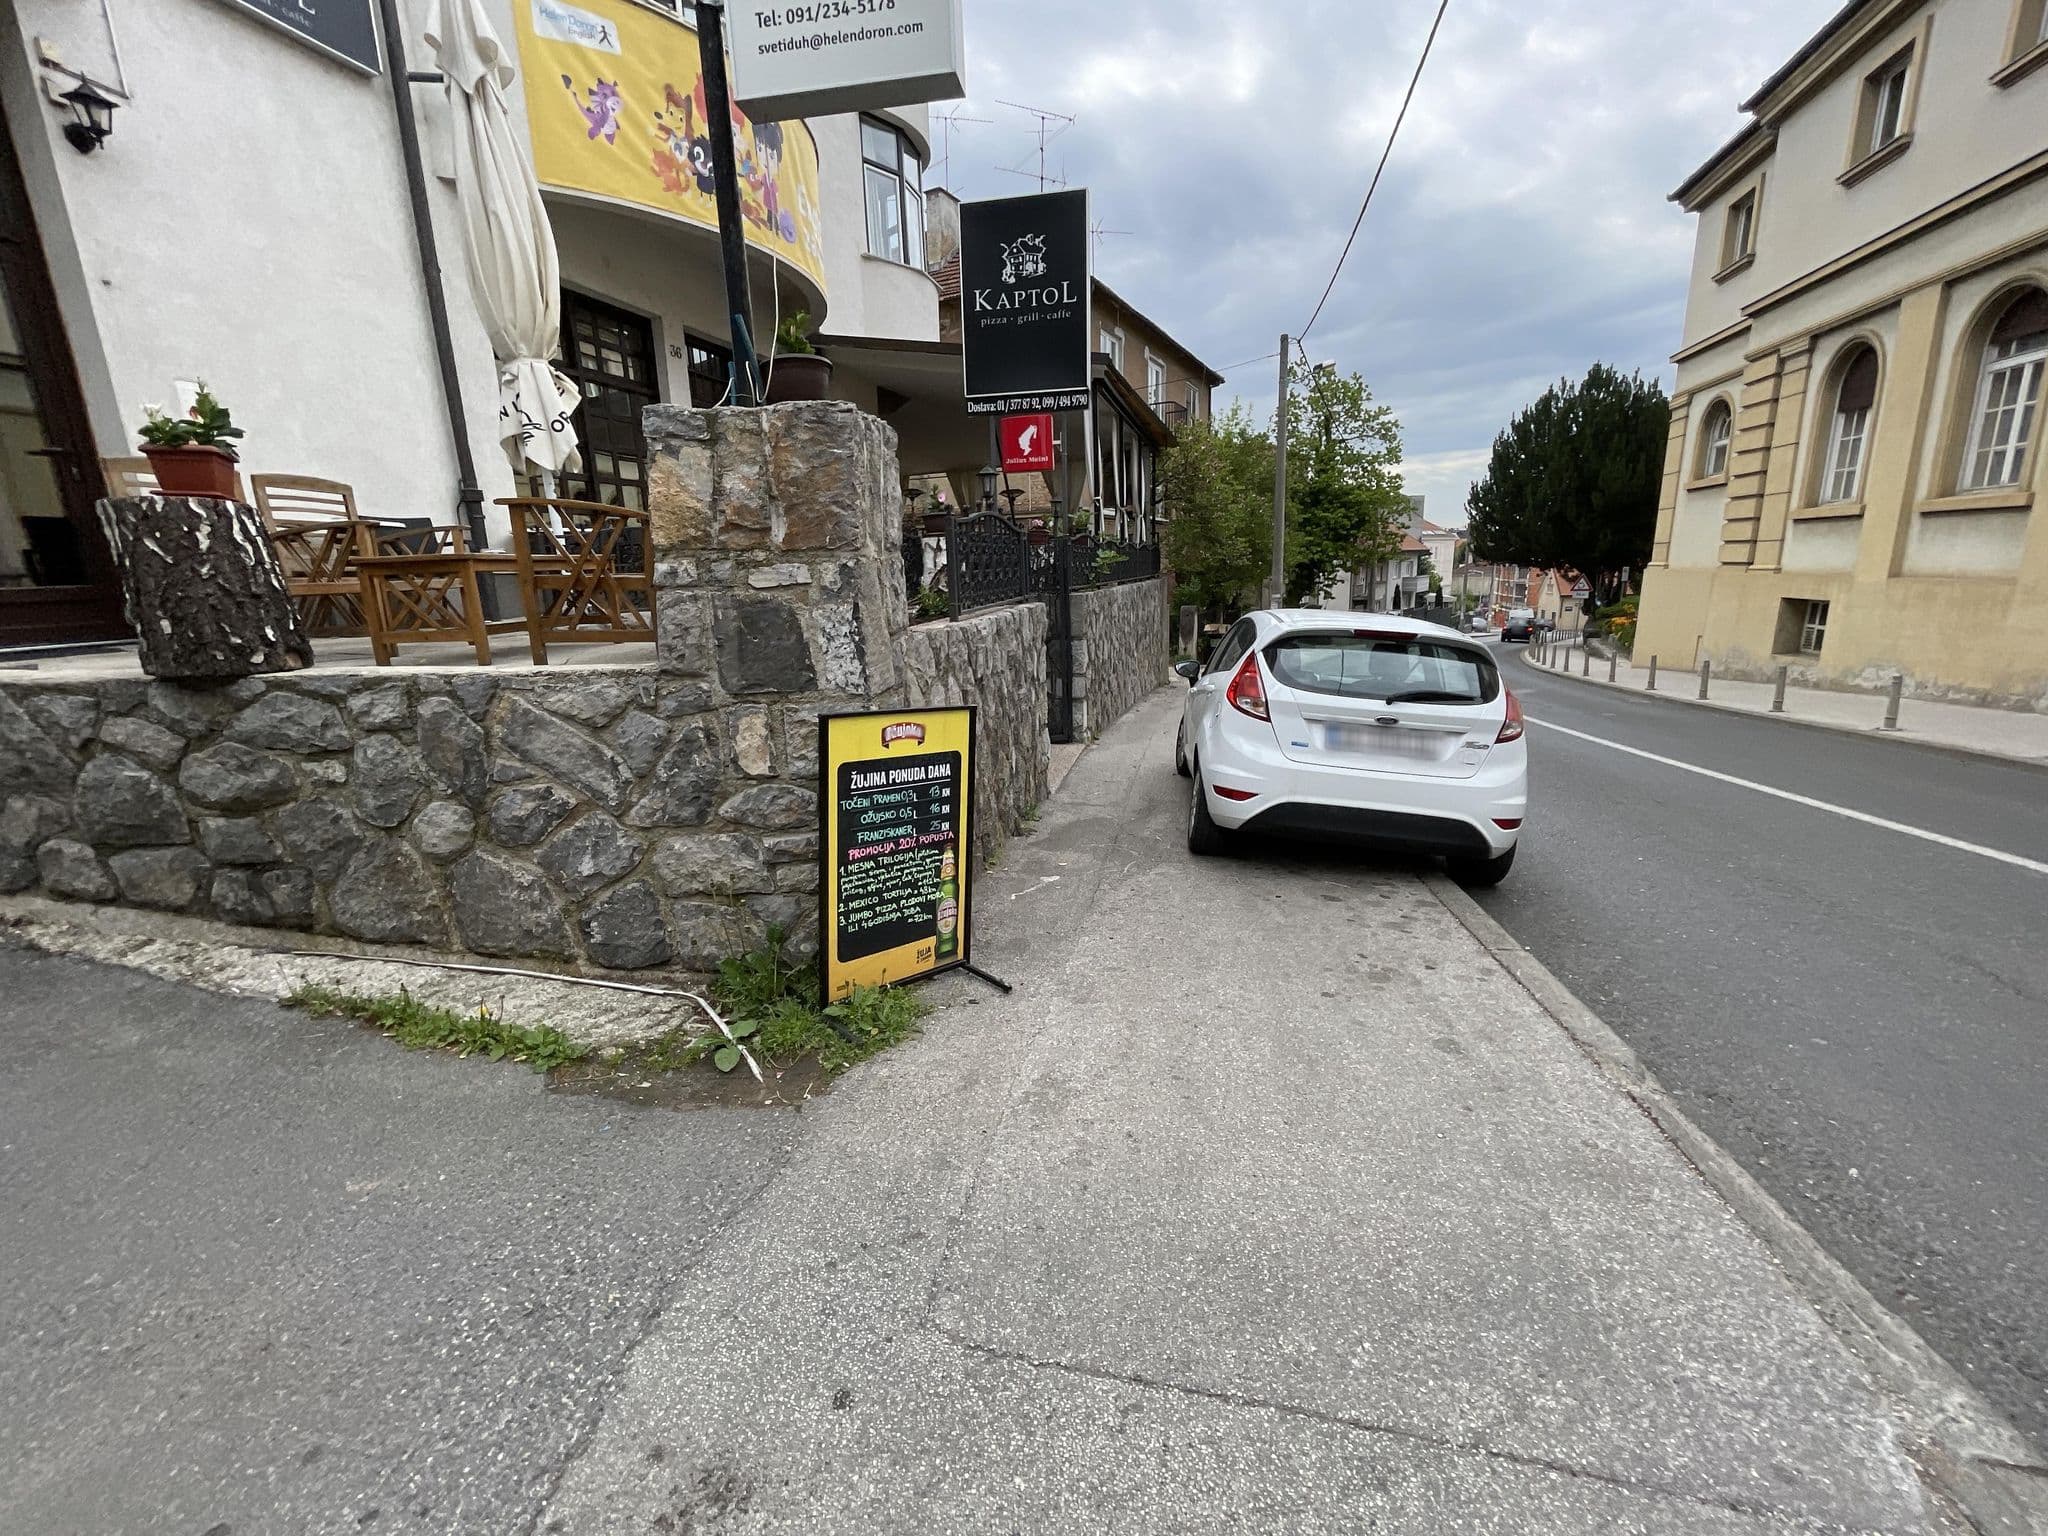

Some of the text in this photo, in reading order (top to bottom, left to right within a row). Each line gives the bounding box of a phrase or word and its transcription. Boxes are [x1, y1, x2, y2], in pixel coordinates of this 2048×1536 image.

[755, 11, 782, 29] Tel:
[758, 21, 924, 55] svetiduh@helendoron.com
[974, 281, 1077, 312] KAPTOL
[980, 309, 1071, 328] pizza grill caffe
[968, 401, 997, 413] Dostava:
[1005, 457, 1027, 465] Julius
[850, 762, 952, 790] ŽUJINA PONUDA DANA
[840, 795, 871, 812] TOČENI
[929, 785, 941, 798] 13
[899, 806, 913, 820] 0,5
[929, 802, 941, 815] 16
[929, 820, 942, 832] 25
[847, 830, 955, 862] PROMOCIJA 20% POPUSTA
[847, 860, 876, 874] MESNA
[848, 895, 879, 910] MEXICO
[848, 910, 874, 923] JUMBO
[875, 902, 898, 914] PIZZA
